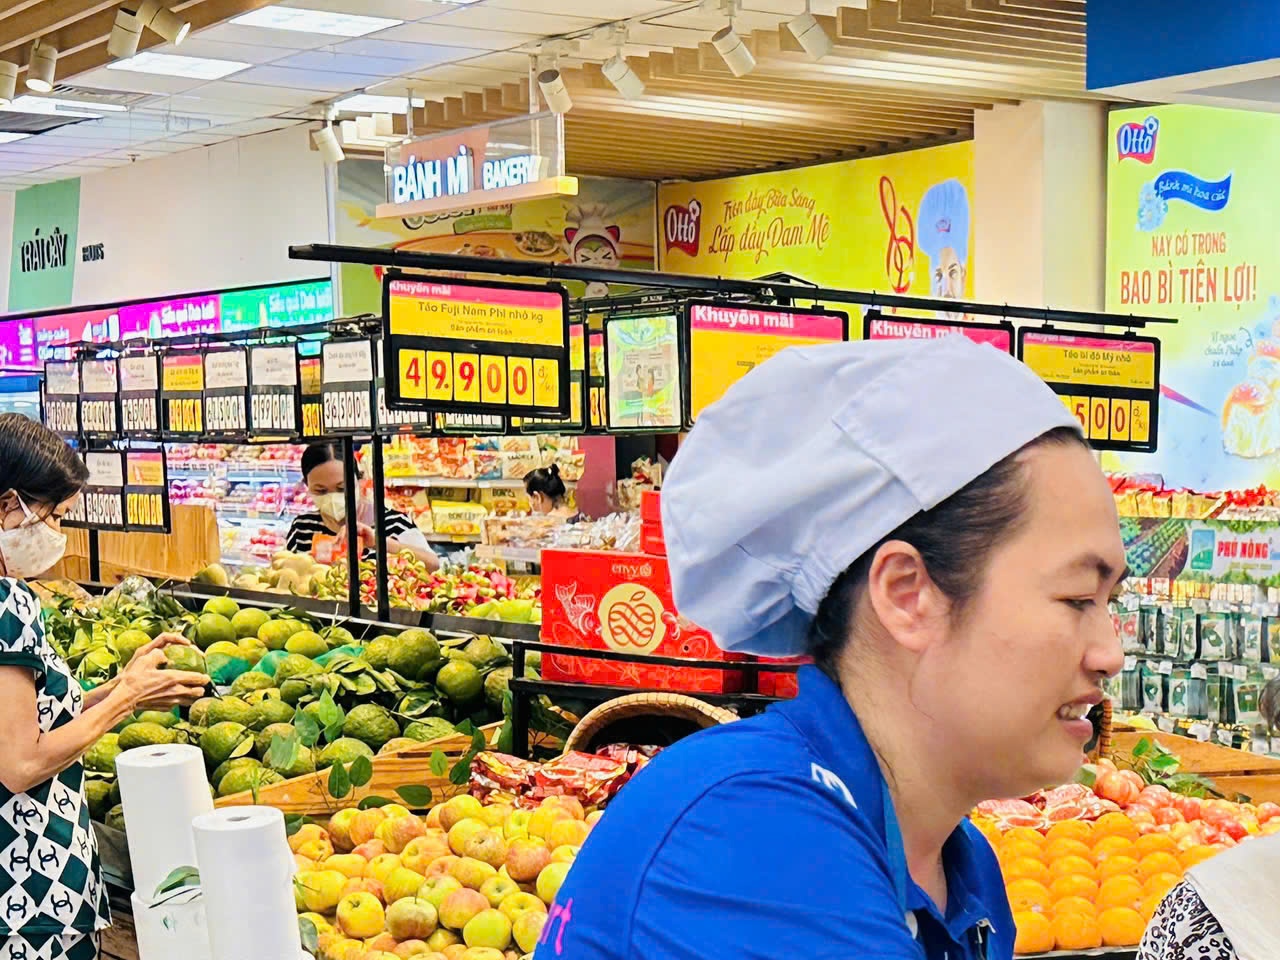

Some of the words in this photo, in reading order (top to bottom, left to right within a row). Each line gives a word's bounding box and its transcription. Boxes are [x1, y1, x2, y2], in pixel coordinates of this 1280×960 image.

[393, 155, 442, 204] BÁNH
[483, 154, 542, 191] BAKERY
[1152, 235, 1172, 257] NAY
[1175, 229, 1188, 255] CÓ
[1192, 231, 1226, 254] TRONG
[1120, 269, 1152, 304] BAO
[1157, 260, 1174, 304] BÌ
[1179, 258, 1218, 312] TIỆN
[1224, 262, 1257, 311] LỢI!
[418, 301, 438, 313] Táo
[440, 303, 460, 316] Fuji
[462, 305, 487, 317] Nam
[531, 311, 544, 324] kg
[611, 563, 639, 580] envy
